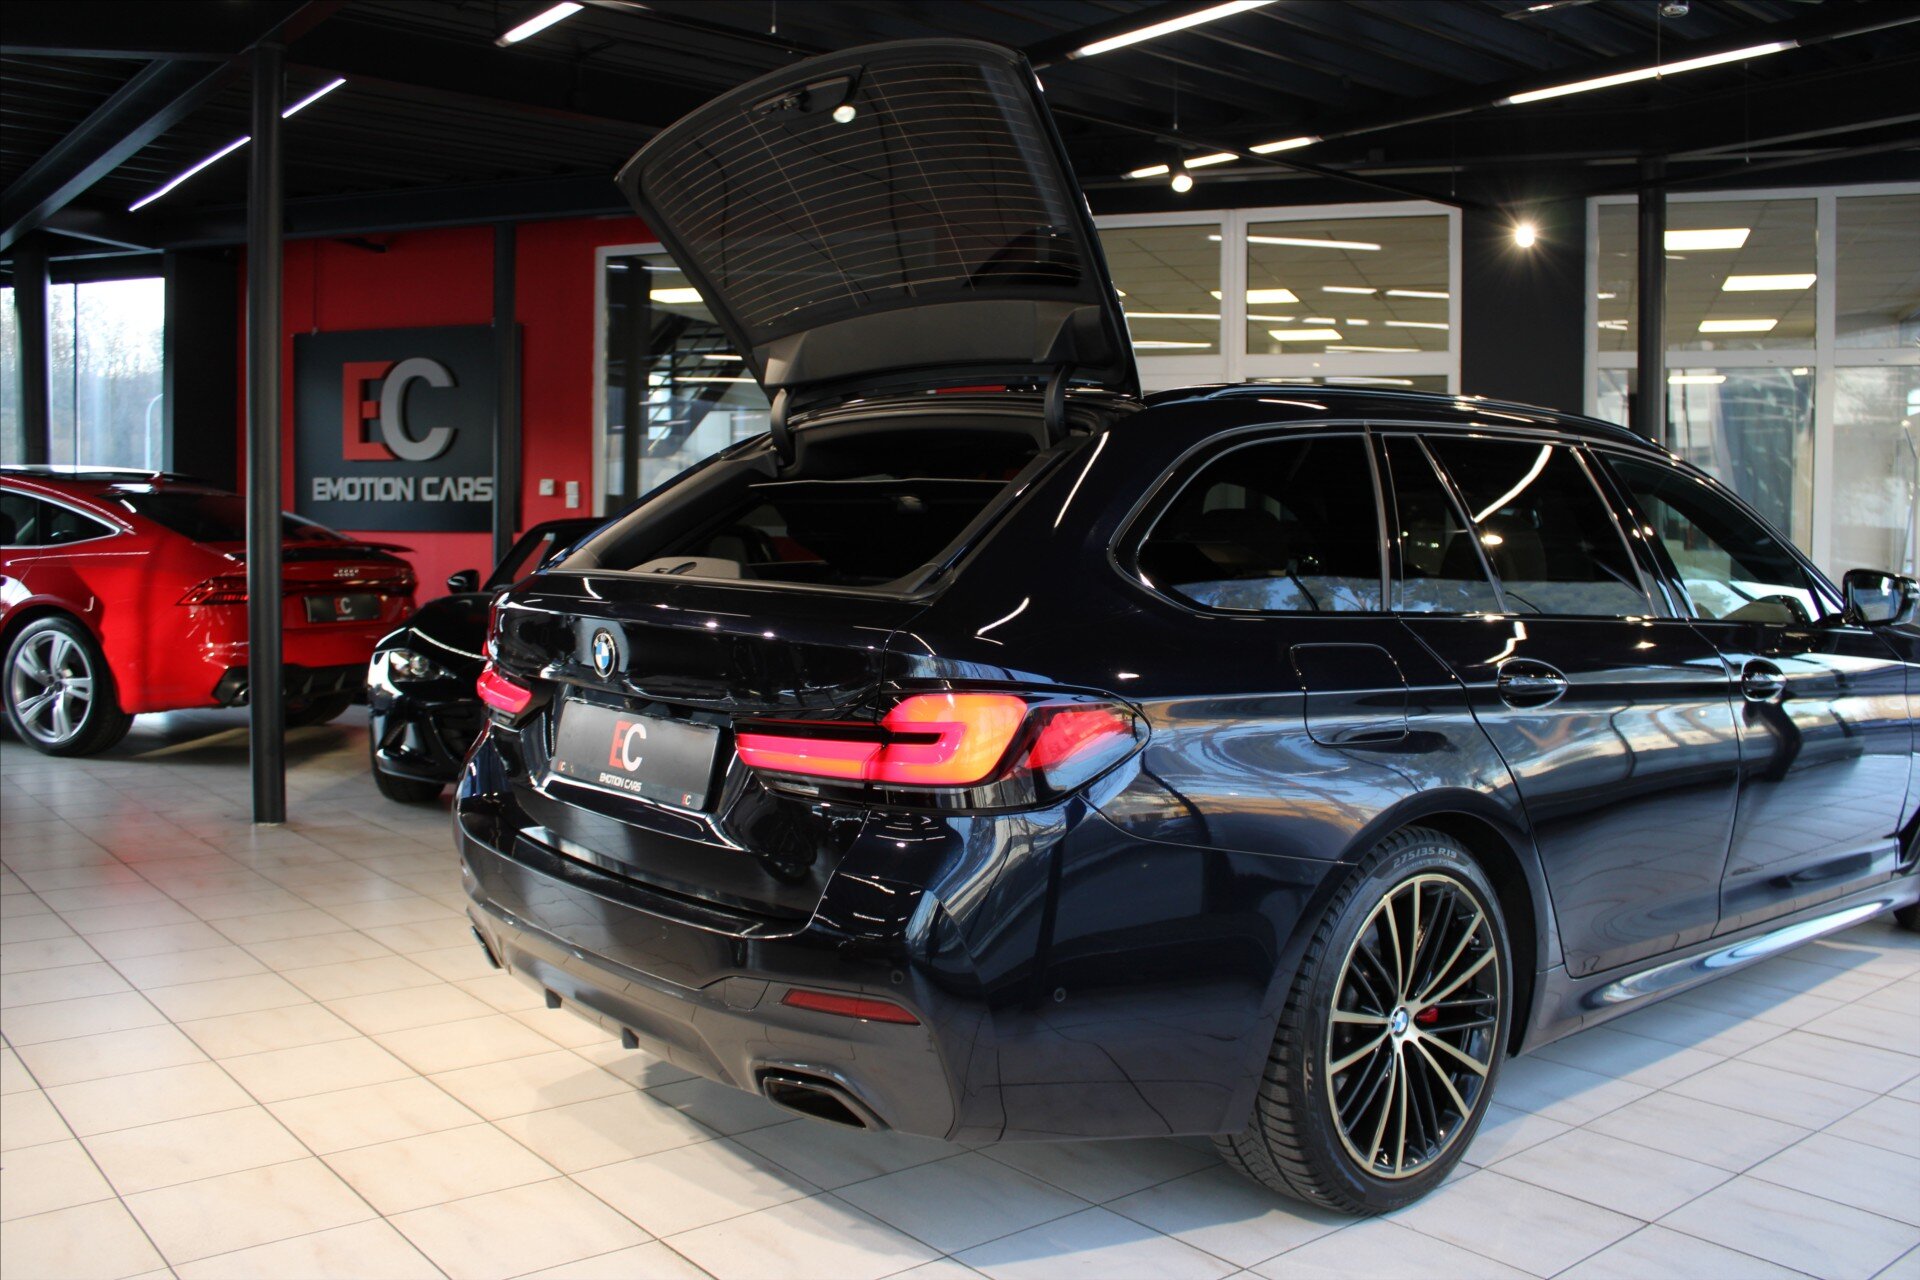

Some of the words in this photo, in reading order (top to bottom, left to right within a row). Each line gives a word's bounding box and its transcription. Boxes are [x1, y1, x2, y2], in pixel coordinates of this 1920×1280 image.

[342, 357, 456, 461] EC
[312, 476, 414, 501] EMOTION
[420, 476, 494, 501] CARS
[609, 719, 647, 772] EC
[599, 772, 624, 788] EMOTION
[624, 779, 643, 792] CARS
[1393, 846, 1436, 869] 275/35
[1438, 847, 1457, 859] R19
